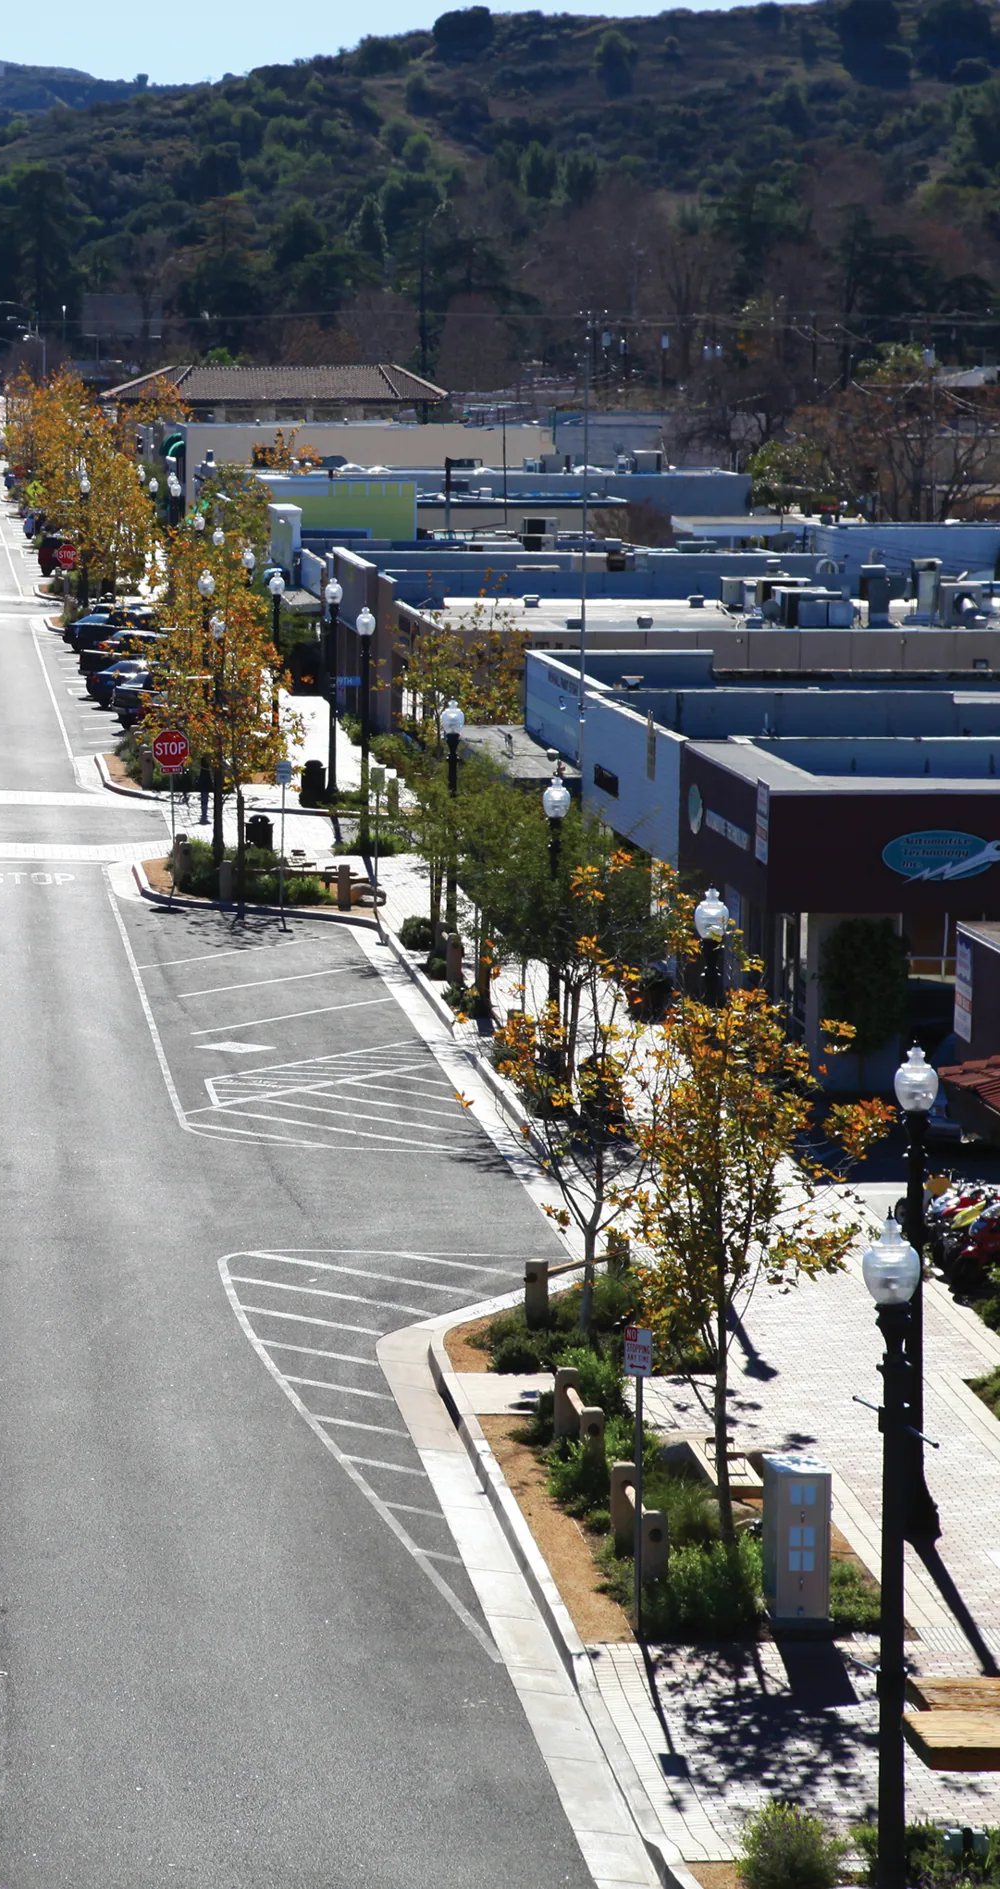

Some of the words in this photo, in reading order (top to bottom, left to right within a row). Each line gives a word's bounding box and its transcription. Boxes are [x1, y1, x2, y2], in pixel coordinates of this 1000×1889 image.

[58, 550, 77, 559] STOP
[155, 741, 187, 756] STOP
[903, 836, 972, 845] Automotive
[903, 848, 969, 858] Technology
[626, 1330, 637, 1340] NO
[626, 1342, 650, 1355] STOPPING
[627, 1353, 637, 1361] ANY
